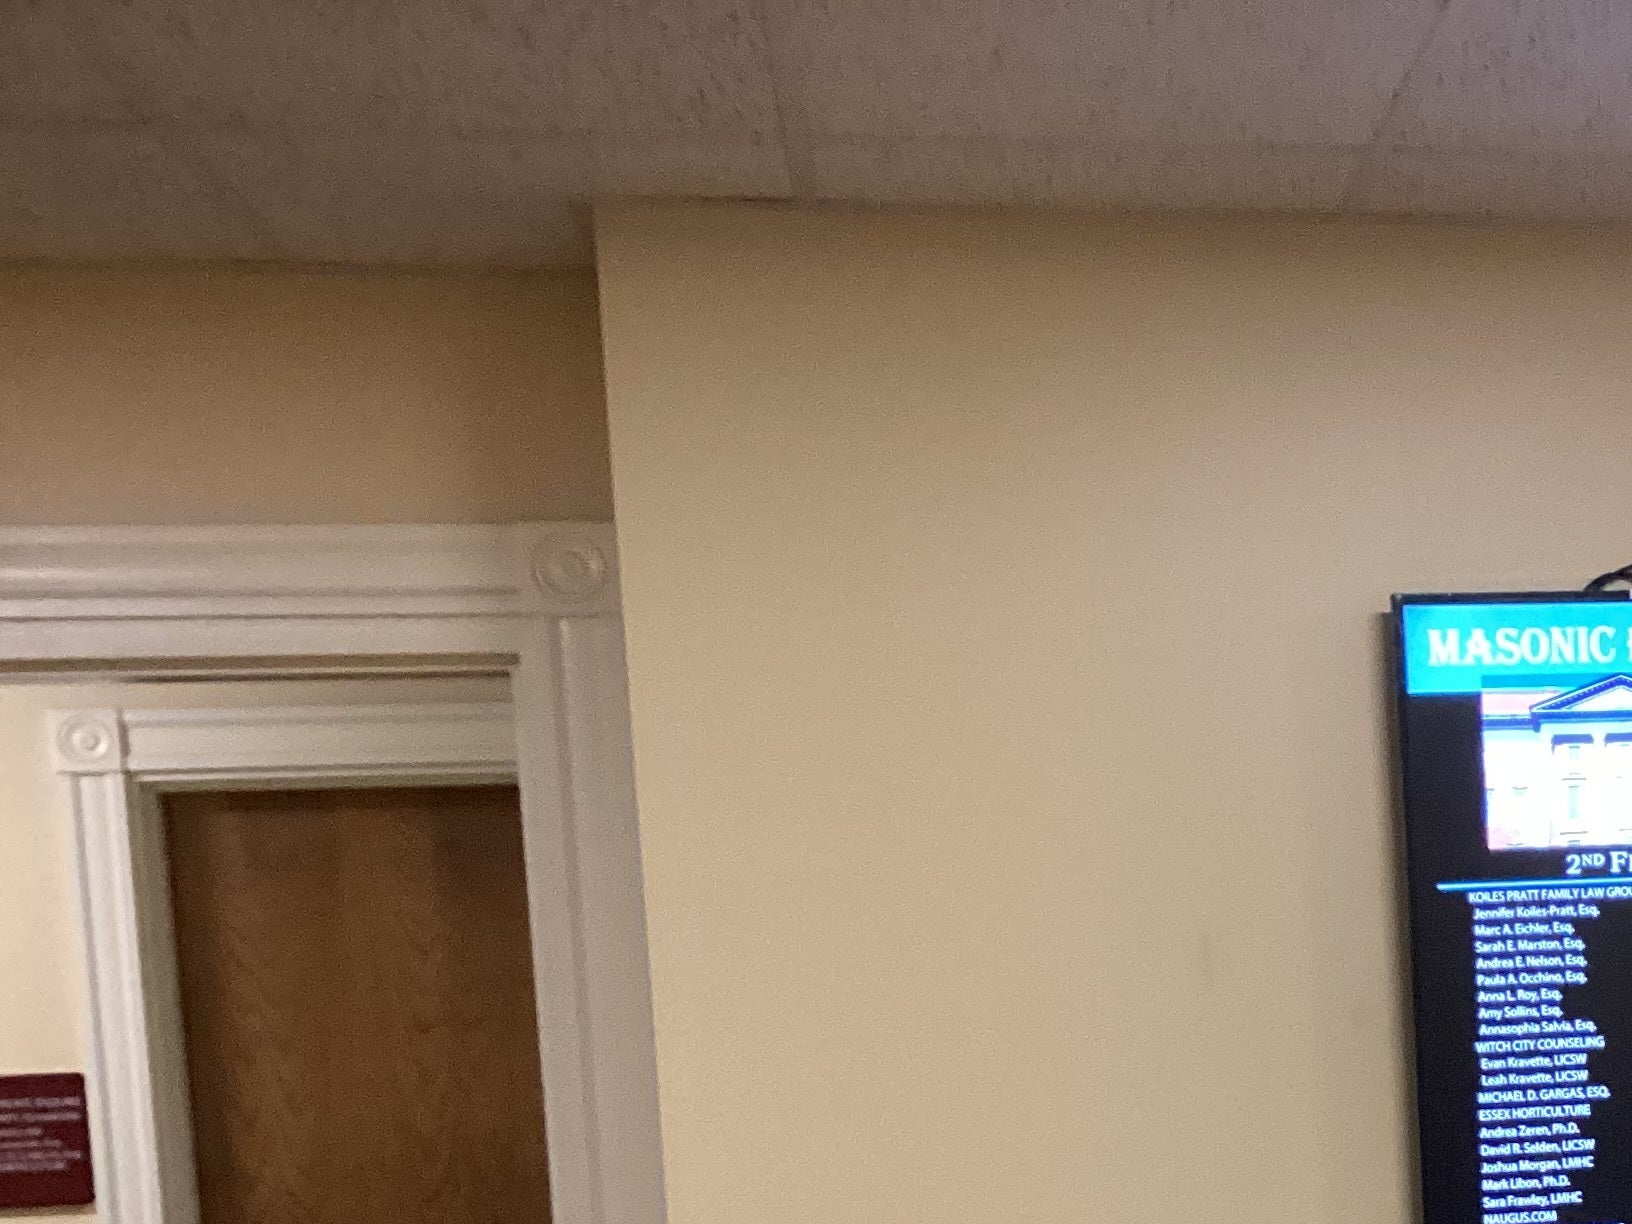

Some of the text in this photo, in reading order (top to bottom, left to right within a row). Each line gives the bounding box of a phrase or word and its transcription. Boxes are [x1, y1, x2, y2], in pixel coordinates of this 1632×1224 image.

[1427, 624, 1616, 667] MASONIC
[1468, 890, 1504, 902] KOILES
[1506, 889, 1538, 901] PRATT
[1541, 888, 1580, 900] FAMILY
[1581, 887, 1604, 898] LAW
[1473, 907, 1514, 920] Jennifer
[1578, 904, 1600, 918] Esq.
[1474, 924, 1500, 936] Marc
[1552, 921, 1575, 935] Esq.
[1475, 942, 1505, 953] Sarah
[1563, 938, 1585, 951] Esq.
[1476, 957, 1514, 969] Andrea
[1526, 955, 1564, 968] Nelson,
[1565, 954, 1587, 967] Esq.
[1476, 974, 1506, 986] Paula
[1565, 970, 1587, 984] Esq.
[1477, 991, 1505, 1002] Anna
[1540, 988, 1563, 1001] Esq.
[1478, 1007, 1503, 1020] Amy
[1540, 1005, 1563, 1018] Esq.
[1479, 1021, 1540, 1035] Annasophia
[1575, 1019, 1597, 1032] Esq.
[1474, 1036, 1605, 1053] WITCH CITY COUNSELING
[1480, 1058, 1507, 1070] Evan
[1481, 1074, 1507, 1086] Leah
[1477, 1090, 1526, 1103] MICHAEL
[1478, 1104, 1591, 1121] ESSEX HORTICULTURE
[1480, 1127, 1517, 1138] Andrea
[1552, 1122, 1580, 1135] Ph.D.
[1480, 1144, 1511, 1156] David
[1481, 1161, 1517, 1174] Joshua
[1562, 1156, 1595, 1169] LMHC
[1481, 1178, 1509, 1191] Mark
[1543, 1175, 1571, 1187] Ph.D.
[1483, 1196, 1506, 1208] Sara
[1550, 1191, 1583, 1204] LMHC
